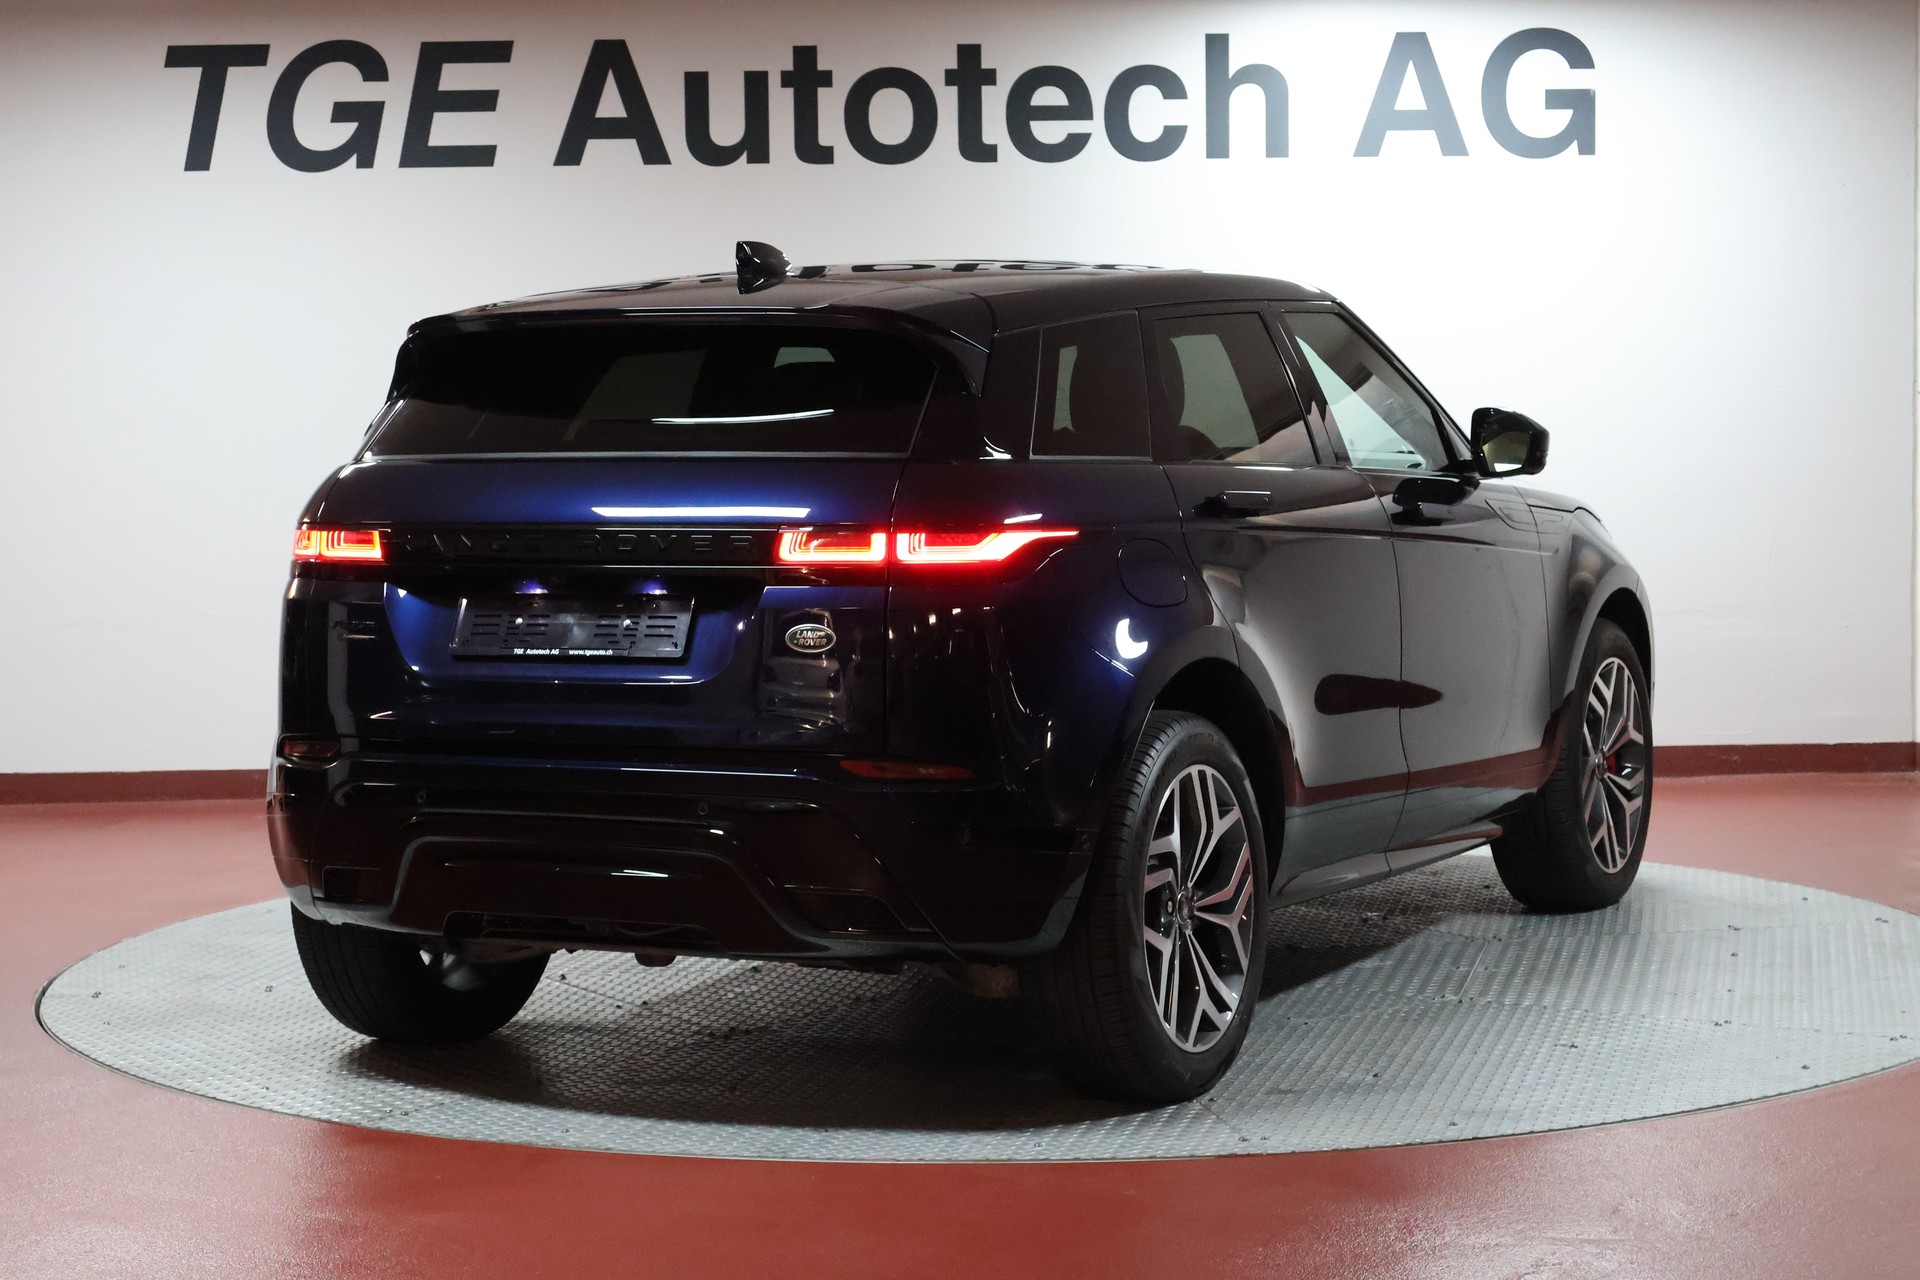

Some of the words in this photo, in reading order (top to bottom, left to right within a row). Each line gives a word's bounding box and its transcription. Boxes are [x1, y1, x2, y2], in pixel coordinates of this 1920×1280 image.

[163, 39, 515, 174] TGE
[553, 33, 1290, 167] Autotech
[1352, 27, 1596, 160] AG
[580, 533, 754, 552] ROVER
[796, 630, 819, 638] LAND
[798, 638, 827, 646] ROVER
